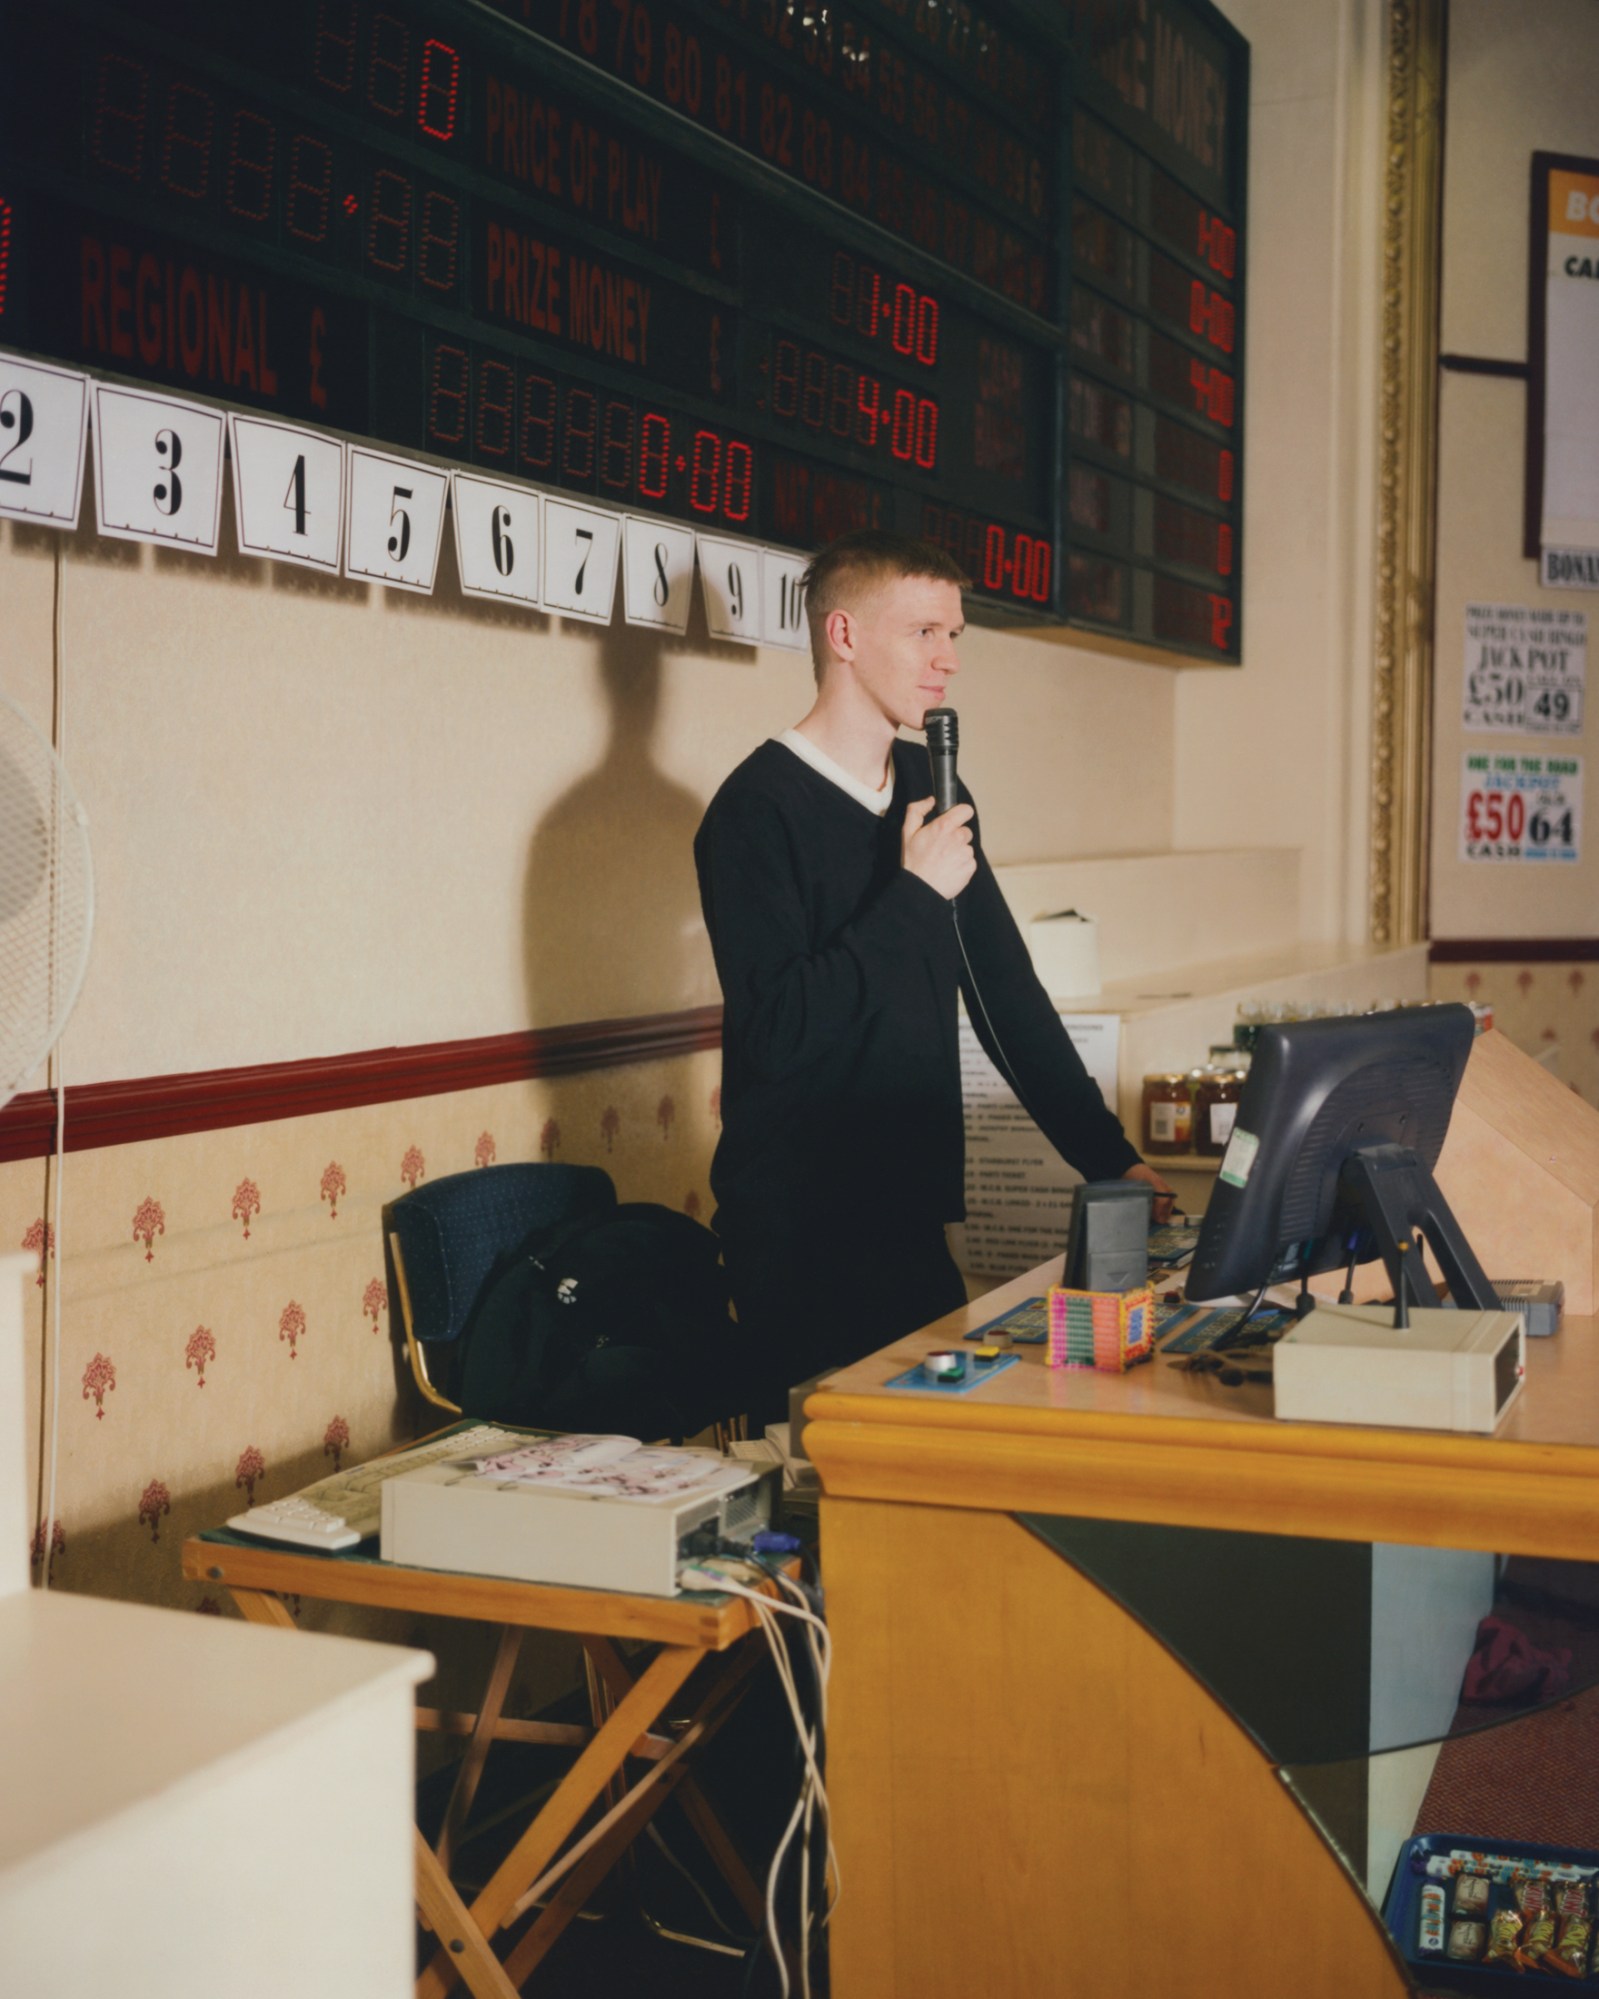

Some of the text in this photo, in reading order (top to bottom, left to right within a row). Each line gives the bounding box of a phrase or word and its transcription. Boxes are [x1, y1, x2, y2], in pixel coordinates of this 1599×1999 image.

[612, 0, 652, 86] 79
[664, 21, 703, 116] 80
[714, 53, 749, 143] 81
[760, 81, 795, 167] 82
[802, 109, 833, 190] 83
[841, 133, 871, 213] 84
[486, 73, 563, 199] PRICE
[569, 117, 601, 210] OF
[607, 137, 664, 240] PLAY
[486, 219, 562, 337] PRIZE
[568, 253, 653, 368] MONEY
[1564, 255, 1599, 280] CA
[80, 234, 278, 398] REGIONAL
[308, 306, 327, 410] £
[0, 389, 34, 486] 2
[154, 429, 182, 515] 3
[284, 454, 312, 536] 4
[387, 485, 413, 562] 5
[492, 505, 514, 577] 6
[575, 528, 594, 596] 7
[654, 543, 669, 607] 8
[728, 562, 743, 622] 9
[779, 571, 806, 633] 10
[1463, 708, 1525, 727] CASH
[1468, 671, 1524, 706] £50
[1534, 690, 1570, 722] 49
[1468, 756, 1490, 771] ONE
[1494, 757, 1516, 772] FOR
[1521, 757, 1542, 773] THE
[1485, 775, 1561, 790] JACKPOT
[1468, 791, 1524, 841] £50
[1529, 806, 1573, 847] 64
[1467, 844, 1521, 859] CASH
